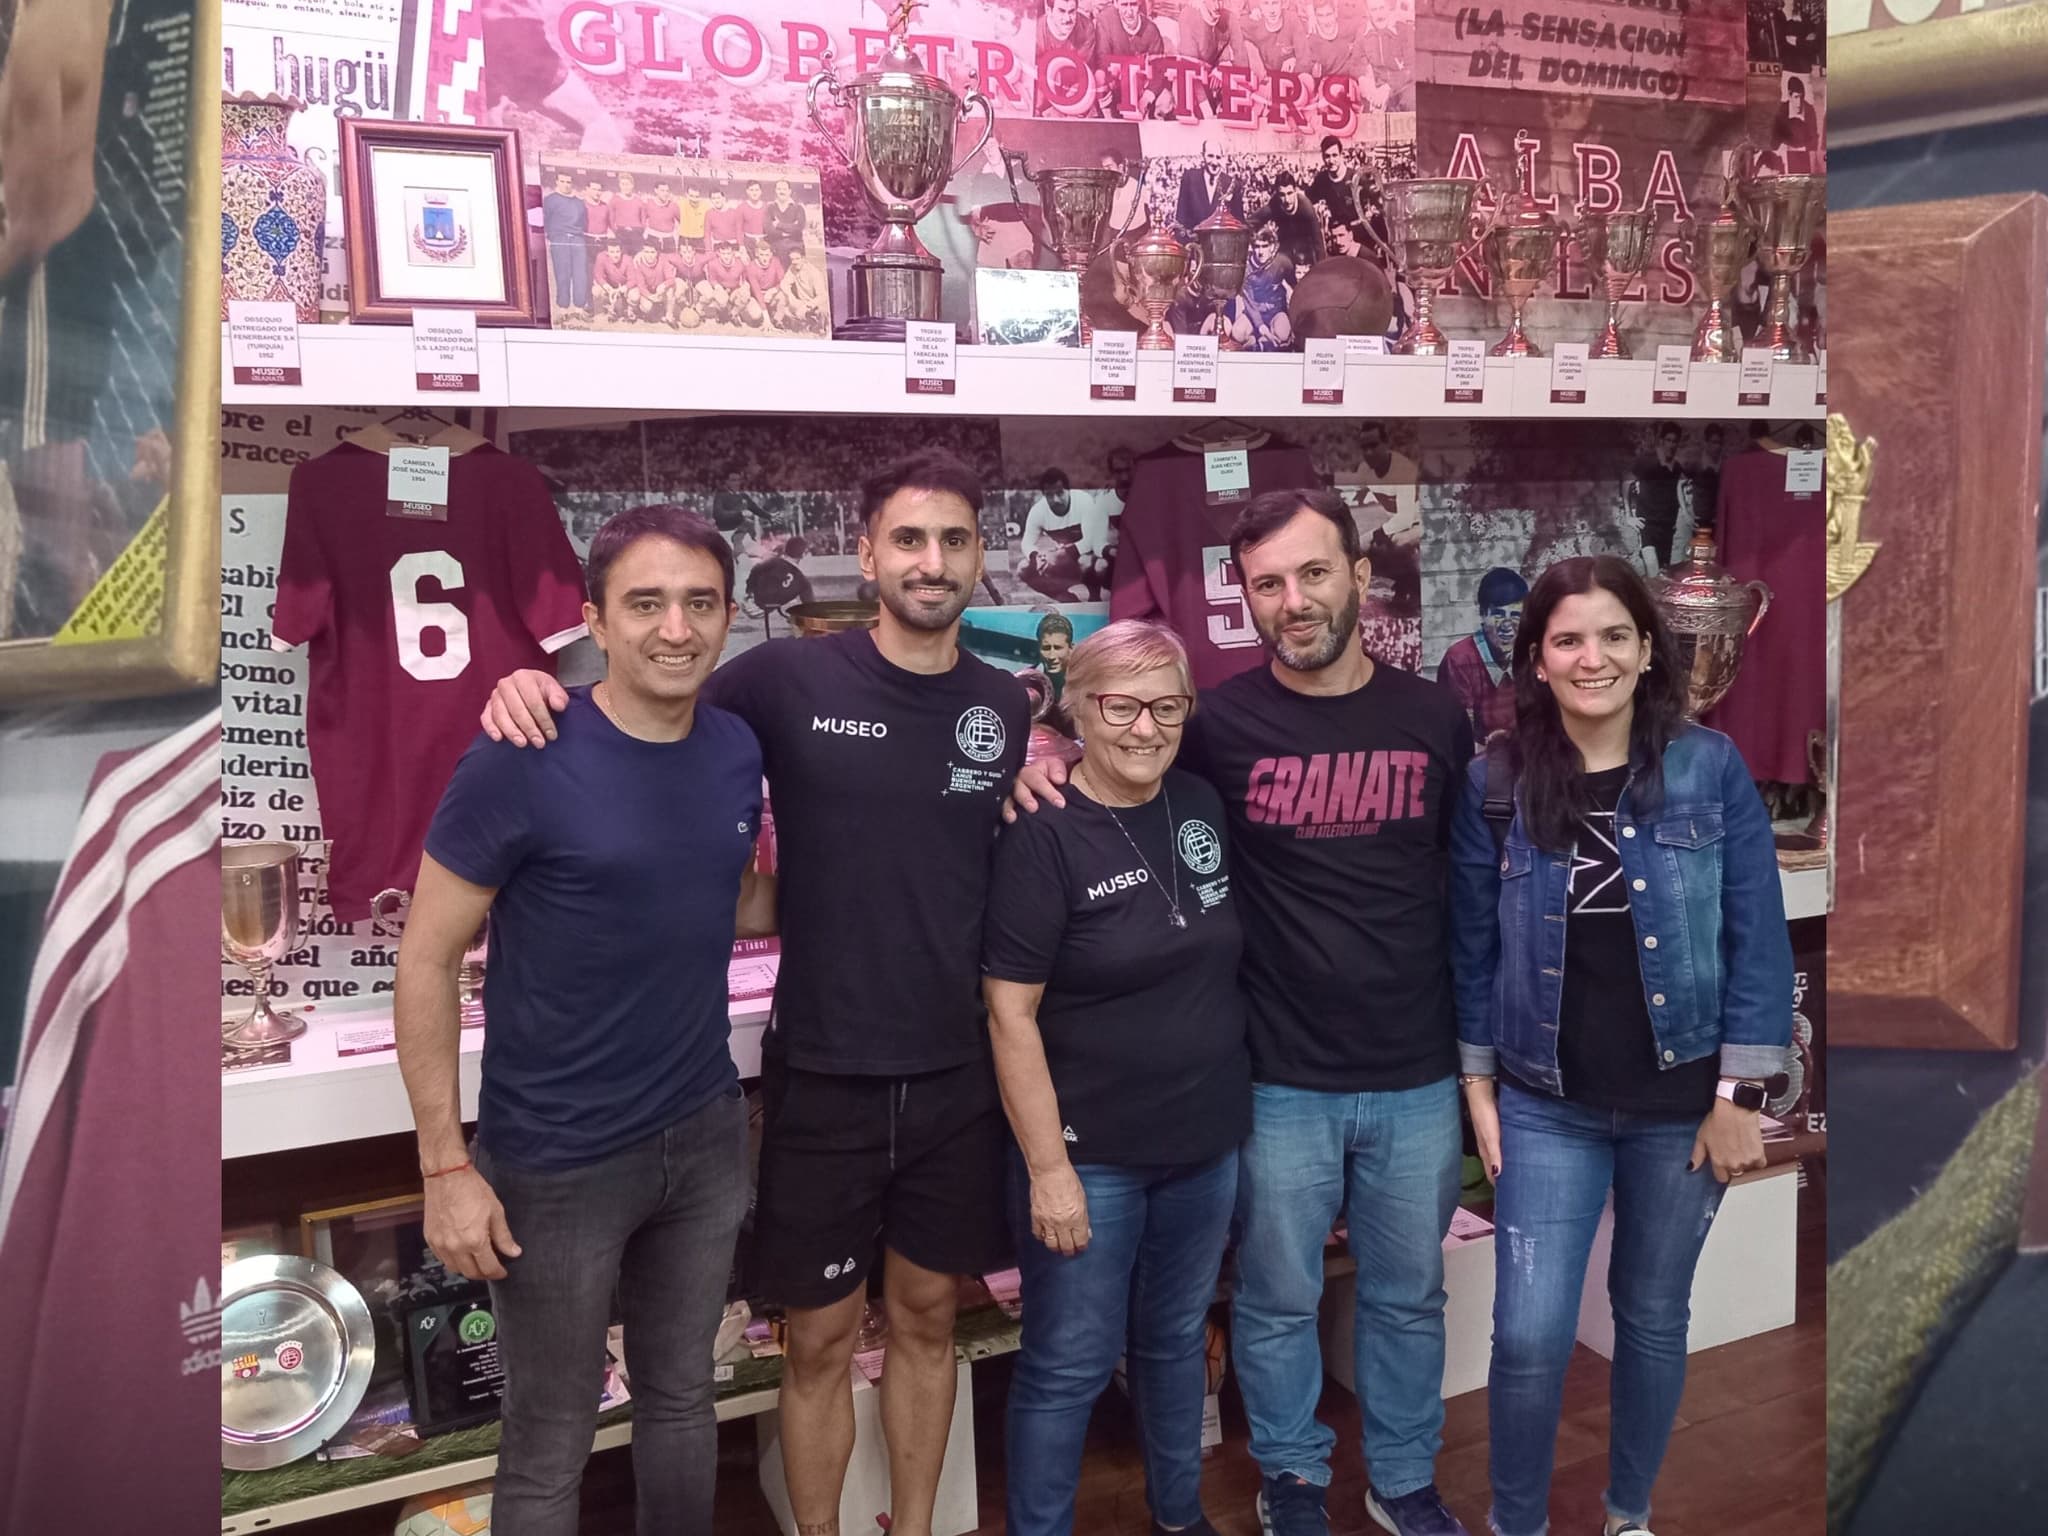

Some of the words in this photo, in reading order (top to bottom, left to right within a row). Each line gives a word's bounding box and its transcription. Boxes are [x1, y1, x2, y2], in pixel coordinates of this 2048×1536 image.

[1521, 12, 1688, 57] SENSACION
[1468, 50, 1523, 81] DEL
[1537, 57, 1688, 101] DOMINGO)
[244, 316, 282, 324] OBSEQUIO
[427, 327, 464, 335] OBSEQUIO
[251, 367, 284, 376] MUSEO
[432, 374, 464, 382] MUSEO
[285, 414, 312, 437] el
[402, 459, 436, 467] CAMISETA
[402, 502, 433, 511] MUSEO
[1202, 545, 1261, 649] 5
[390, 550, 471, 681] 6
[232, 691, 302, 716] vital
[811, 715, 888, 739] MUSEO
[1245, 750, 1429, 825] GRANATE
[268, 788, 304, 811] de
[1087, 868, 1149, 900] MUSEO
[302, 979, 359, 1001] que
